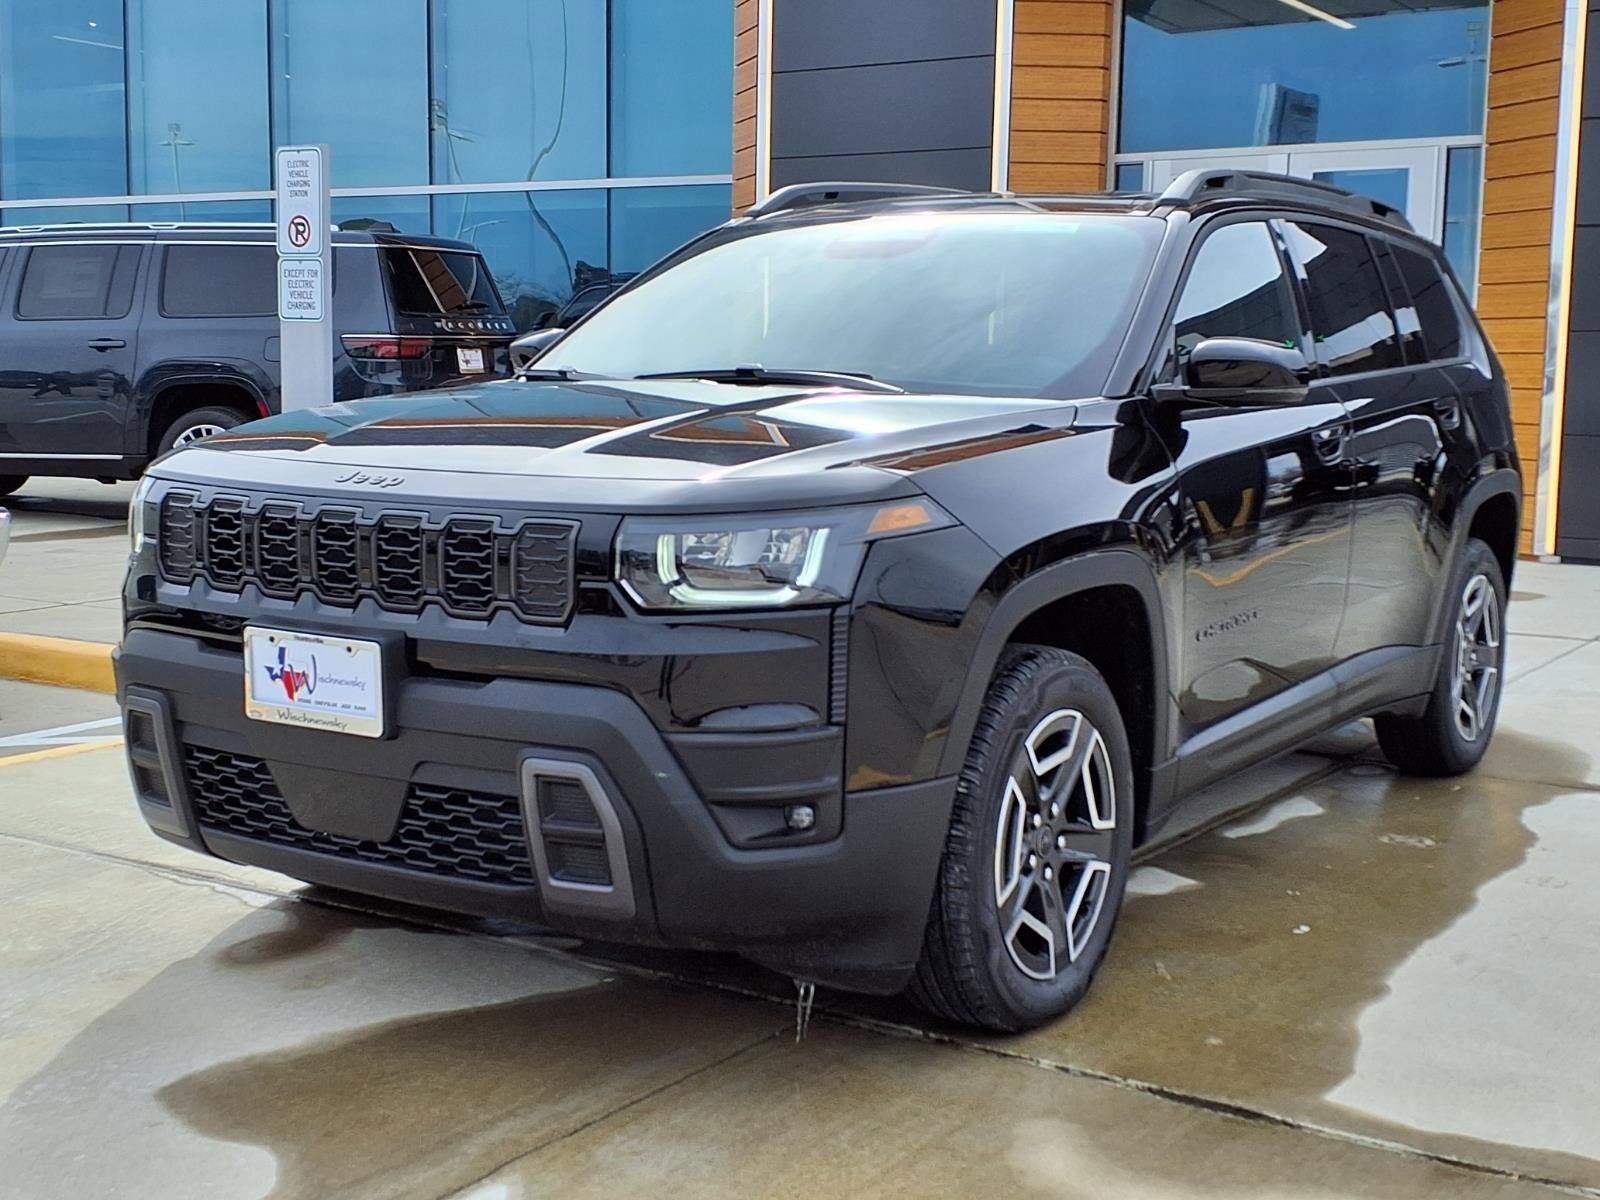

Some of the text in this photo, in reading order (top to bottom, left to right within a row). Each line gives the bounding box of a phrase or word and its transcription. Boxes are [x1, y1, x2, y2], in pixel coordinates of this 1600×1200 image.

[287, 160, 309, 168] ELECTRIC
[284, 269, 318, 277] EXCEPT FOR
[287, 280, 314, 288] ELECTRIC
[289, 291, 313, 299] VEHICLE
[287, 301, 316, 310] CHARGING
[334, 471, 405, 489] Jeep
